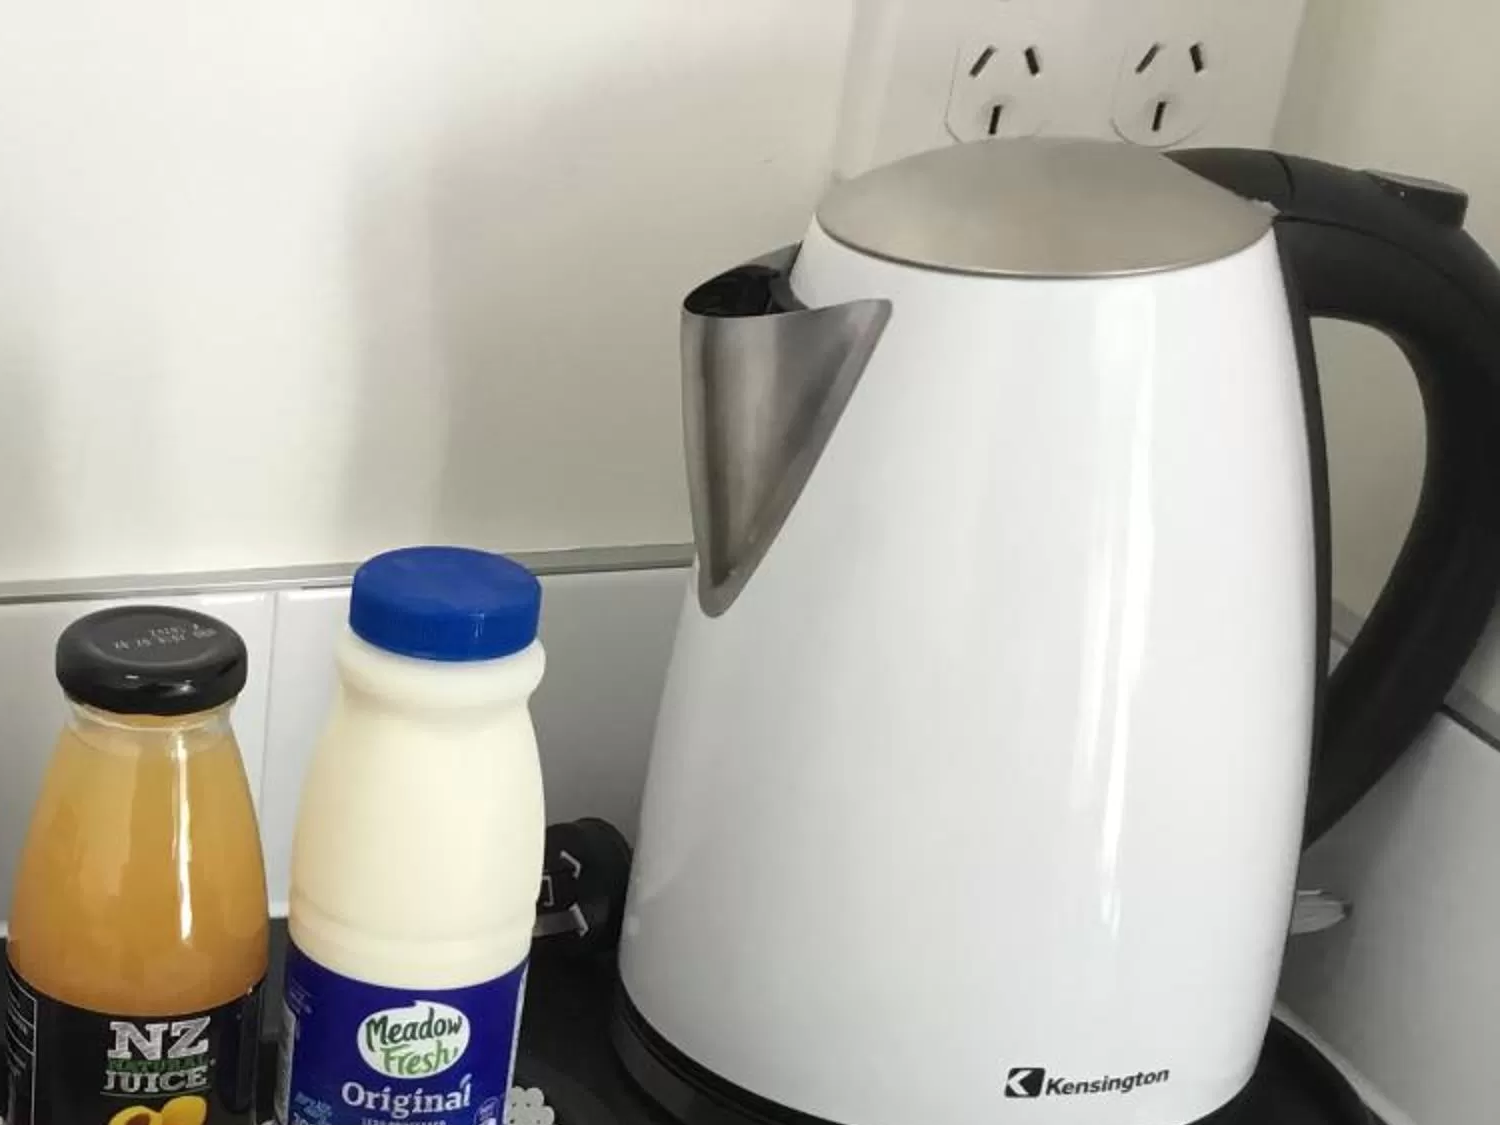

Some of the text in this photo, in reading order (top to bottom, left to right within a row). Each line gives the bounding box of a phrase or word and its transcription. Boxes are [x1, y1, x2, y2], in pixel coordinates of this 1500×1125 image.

[107, 1015, 212, 1060] NZ
[365, 1007, 463, 1052] Meadow
[380, 1039, 452, 1076] Fresh
[103, 1066, 208, 1093] JUICE
[341, 1073, 473, 1120] Original
[1045, 1067, 1170, 1097] Kensington
